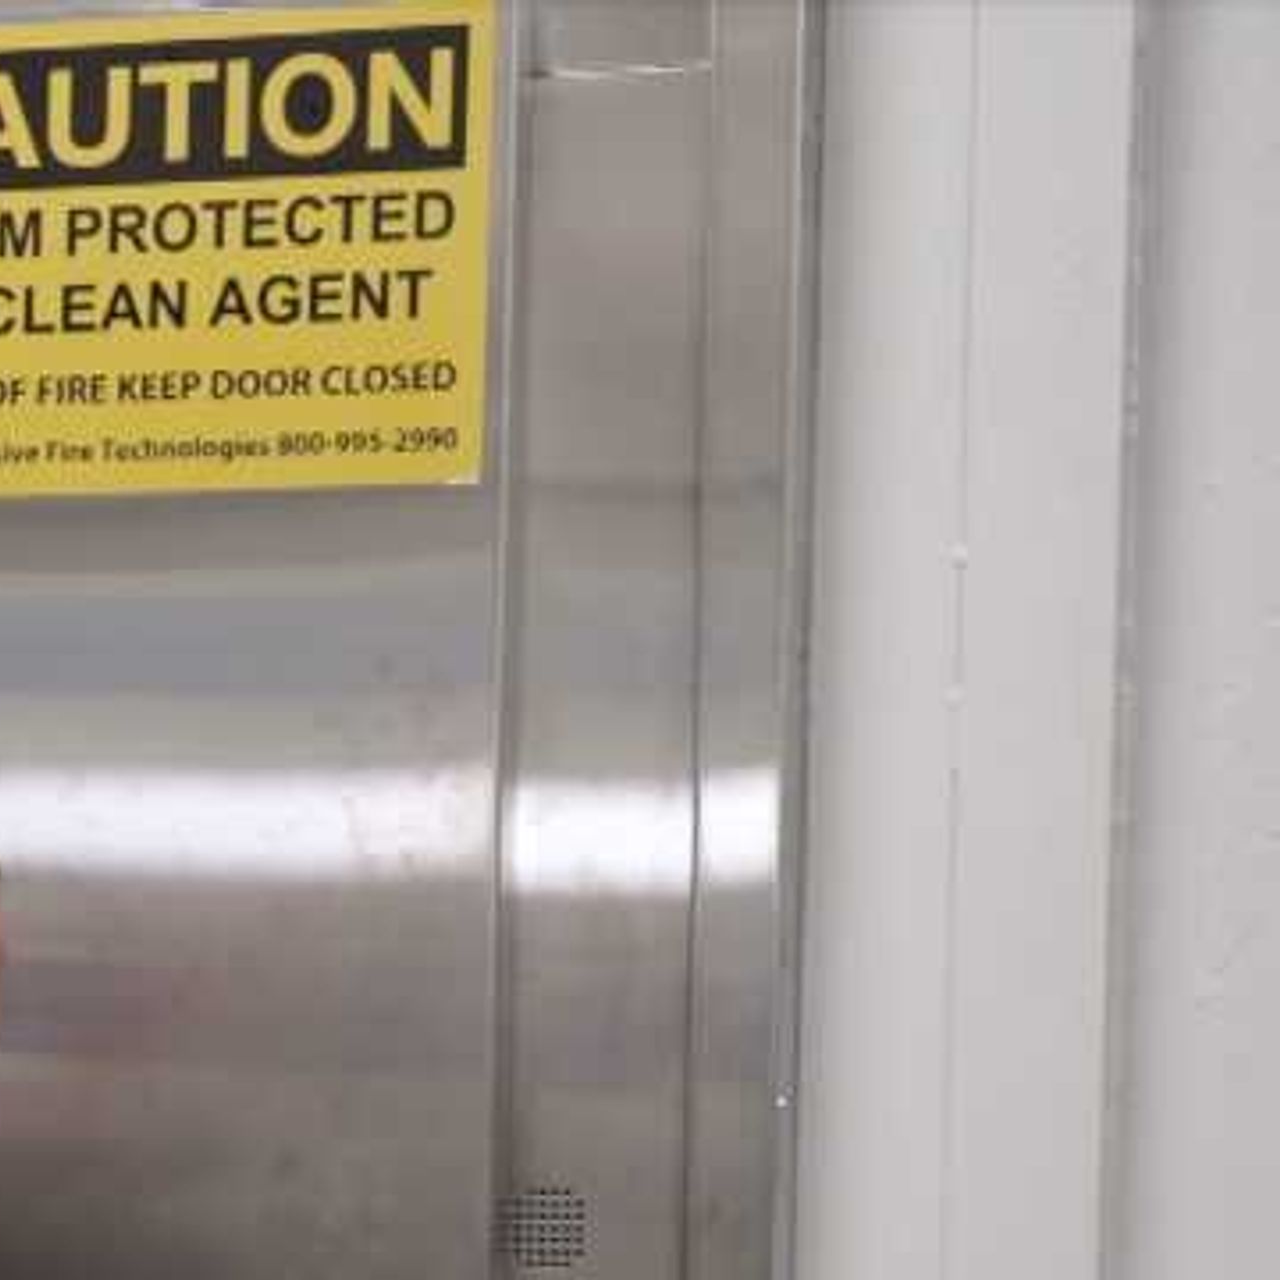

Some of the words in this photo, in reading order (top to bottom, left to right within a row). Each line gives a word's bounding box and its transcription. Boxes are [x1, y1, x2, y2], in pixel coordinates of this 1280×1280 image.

[66, 190, 456, 257] PROTECTED
[209, 270, 434, 328] AGENT
[37, 373, 107, 404] FIRE
[117, 369, 201, 400] KEEP
[210, 367, 312, 400] DOOR
[321, 360, 457, 396] CLOSED
[44, 440, 95, 462] Fire
[102, 435, 269, 463] Technologies
